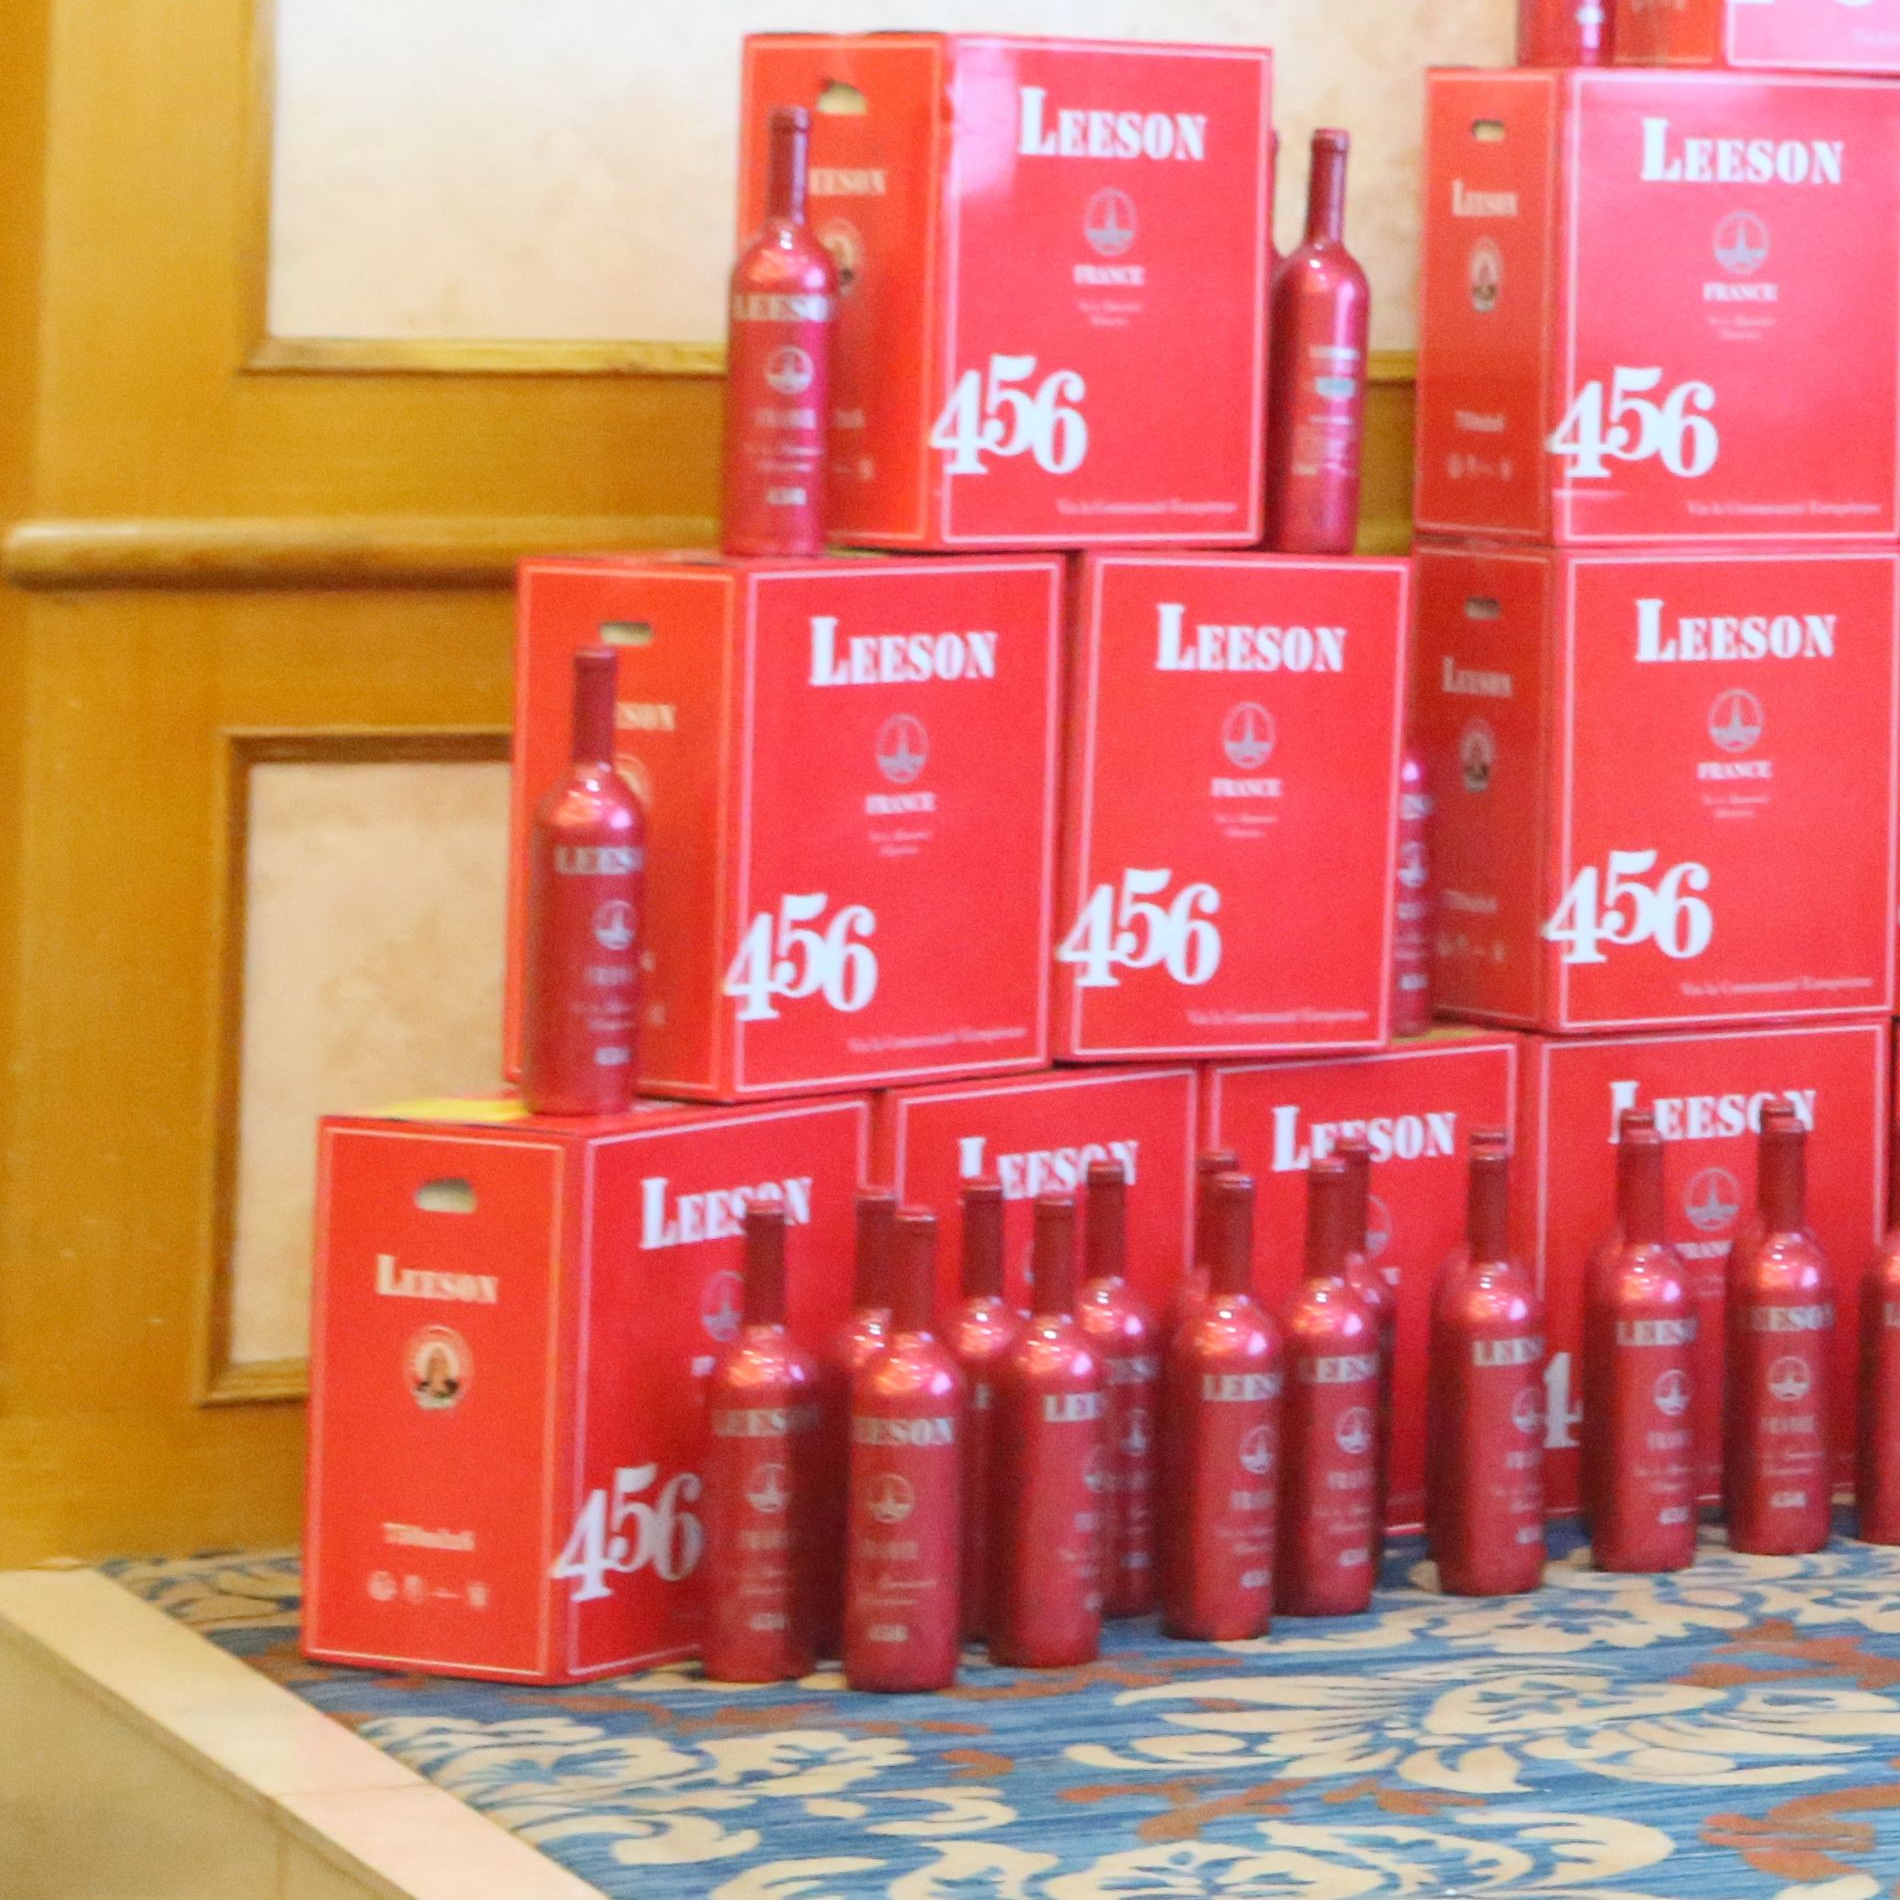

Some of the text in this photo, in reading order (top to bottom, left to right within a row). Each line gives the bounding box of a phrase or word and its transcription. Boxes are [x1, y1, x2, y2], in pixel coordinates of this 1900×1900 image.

[1019, 82, 1206, 160] LEESON
[1640, 115, 1843, 184] LEESON
[1073, 264, 1144, 286] FRANCE
[1703, 282, 1777, 301] FRANCE
[931, 354, 1087, 477] 456
[1546, 366, 1718, 479] 456
[809, 616, 997, 686] LEESON
[1156, 603, 1346, 672] LEESON
[1635, 598, 1836, 662] LEESON
[865, 792, 935, 815] FRANCE
[1211, 778, 1281, 797] FRANCE
[1698, 760, 1772, 780] FRANCE
[1058, 867, 1222, 989] 456
[1543, 849, 1712, 964] 456
[724, 893, 876, 1022] 456
[376, 1254, 498, 1303] LEESON
[550, 1462, 704, 1602] 456
